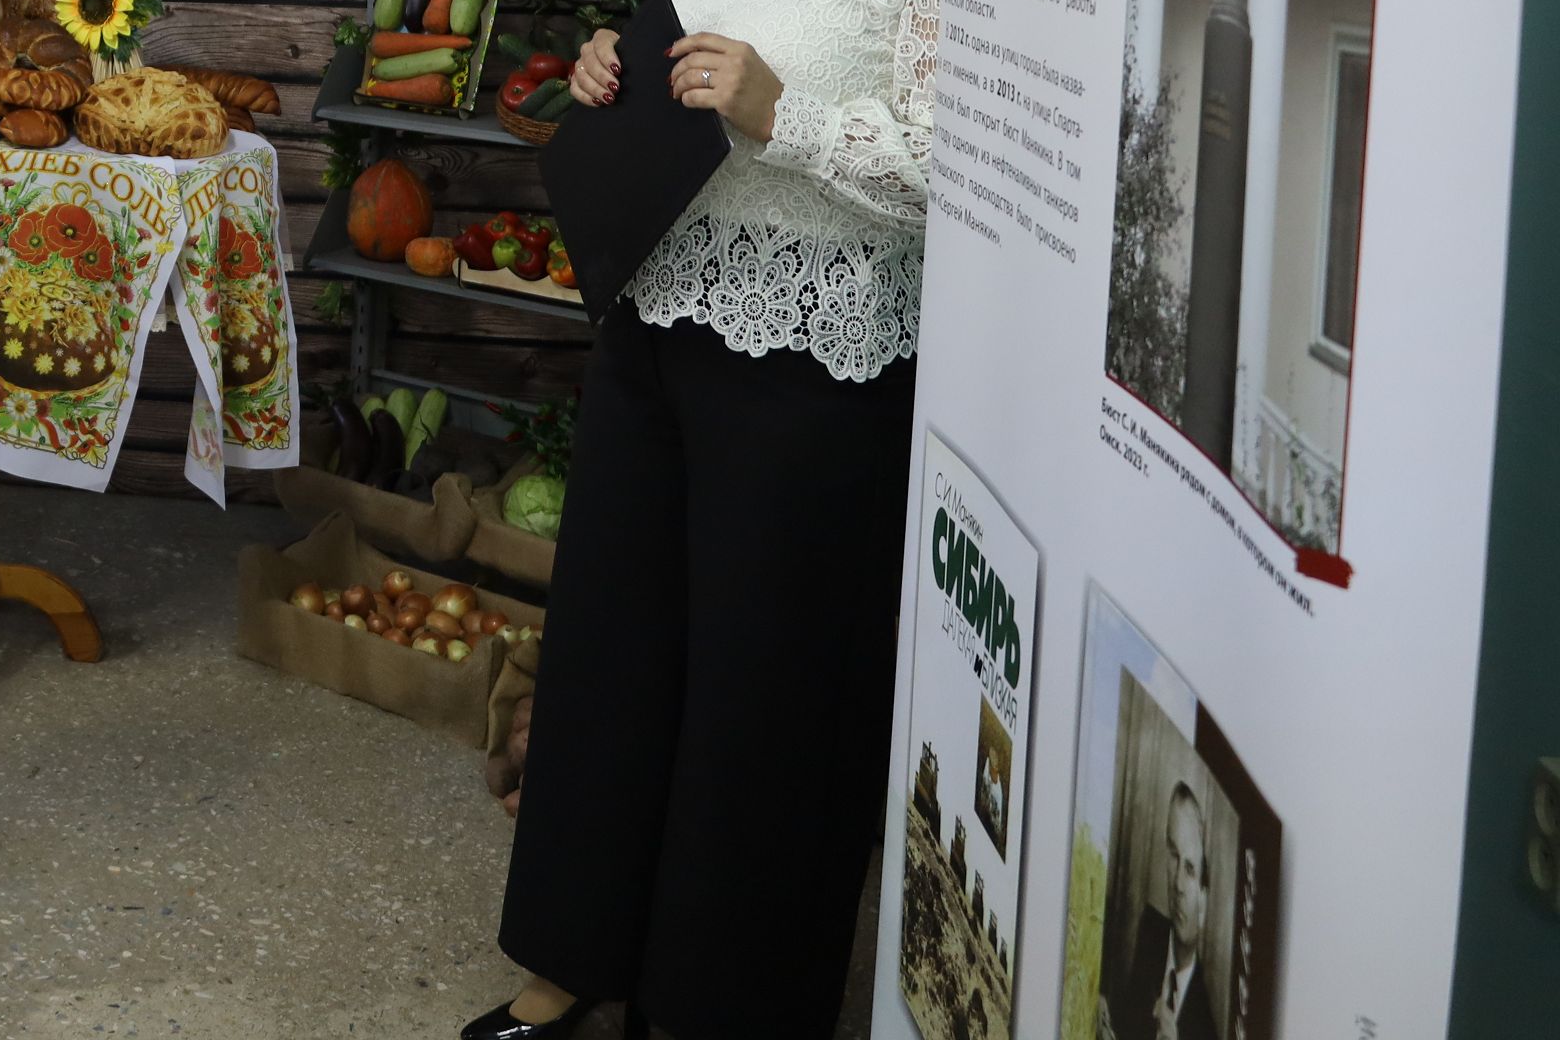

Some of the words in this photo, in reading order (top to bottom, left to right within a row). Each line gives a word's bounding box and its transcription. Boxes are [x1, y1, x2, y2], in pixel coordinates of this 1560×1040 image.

[943, 59, 952, 75] его
[952, 64, 981, 90] именем,
[982, 76, 988, 91] а
[989, 79, 995, 93] в
[997, 78, 1015, 102] 2013
[1016, 91, 1022, 107] г.
[1023, 94, 1031, 112] на
[1053, 106, 1084, 139] Спарта-
[949, 23, 964, 46] 2012
[964, 33, 971, 48] г.
[971, 35, 990, 56] одна
[991, 42, 1001, 59] из
[1001, 45, 1019, 68] улиц
[1019, 53, 1042, 78] города
[1042, 59, 1059, 86] была
[1060, 73, 1086, 97] назва-
[935, 89, 955, 112] овской
[956, 96, 970, 120] был
[973, 109, 1000, 133] открыт
[1002, 117, 1019, 143] бюст
[1057, 150, 1063, 171] В
[1066, 159, 1081, 182] том
[938, 126, 952, 149] году
[952, 134, 980, 164] одному
[980, 148, 990, 166] из
[1043, 187, 1079, 223] танкеров
[89, 161, 168, 237] СОЛЬ
[184, 172, 222, 227] ЛЕ
[931, 155, 965, 188] ртышского
[968, 178, 1014, 217] пароходства
[1015, 203, 1033, 233] было
[1035, 223, 1076, 264] присвоено
[1099, 424, 1122, 455] Омск.
[1101, 396, 1120, 424] Бюст
[1139, 426, 1179, 475] Манякина
[932, 506, 1020, 690] СИБИРЬ
[942, 598, 976, 666] ДАЛЕКАЯ
[981, 651, 1018, 736] БЛИЗКАЯ
